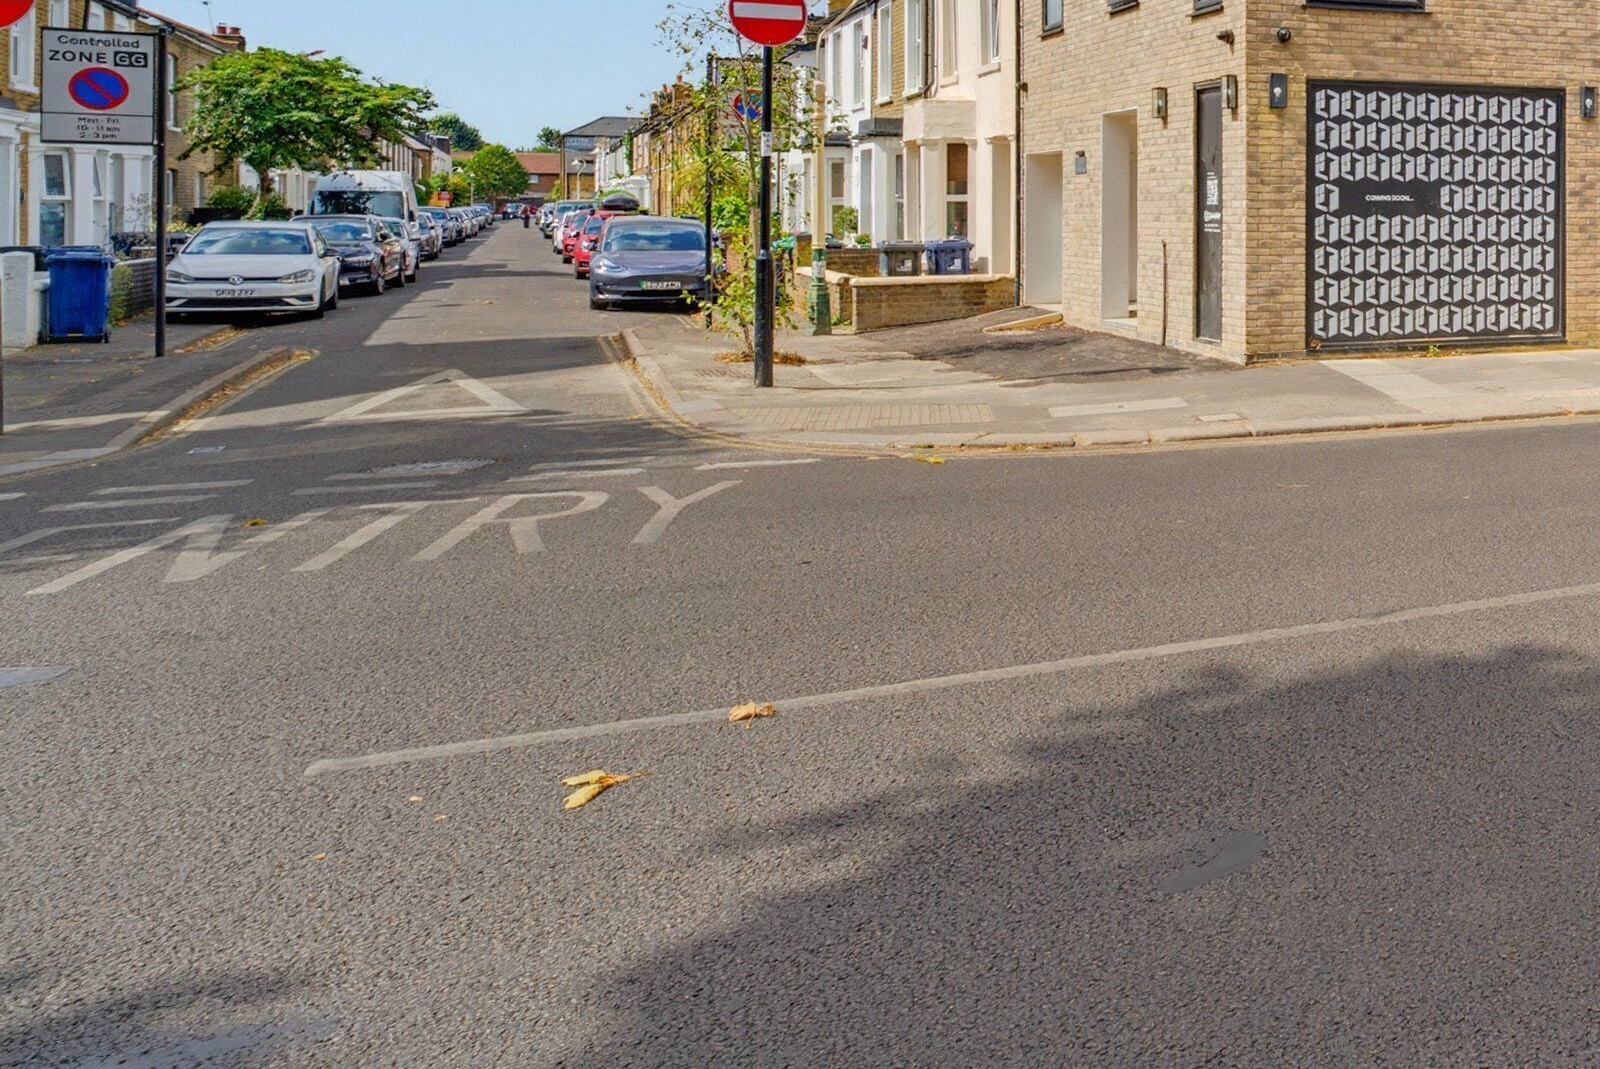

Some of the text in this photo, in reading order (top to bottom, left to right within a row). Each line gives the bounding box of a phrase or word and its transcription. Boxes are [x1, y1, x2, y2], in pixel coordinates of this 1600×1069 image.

[57, 35, 140, 48] Controlled
[48, 50, 147, 66] ZONE GG
[1365, 194, 1392, 202] COMING
